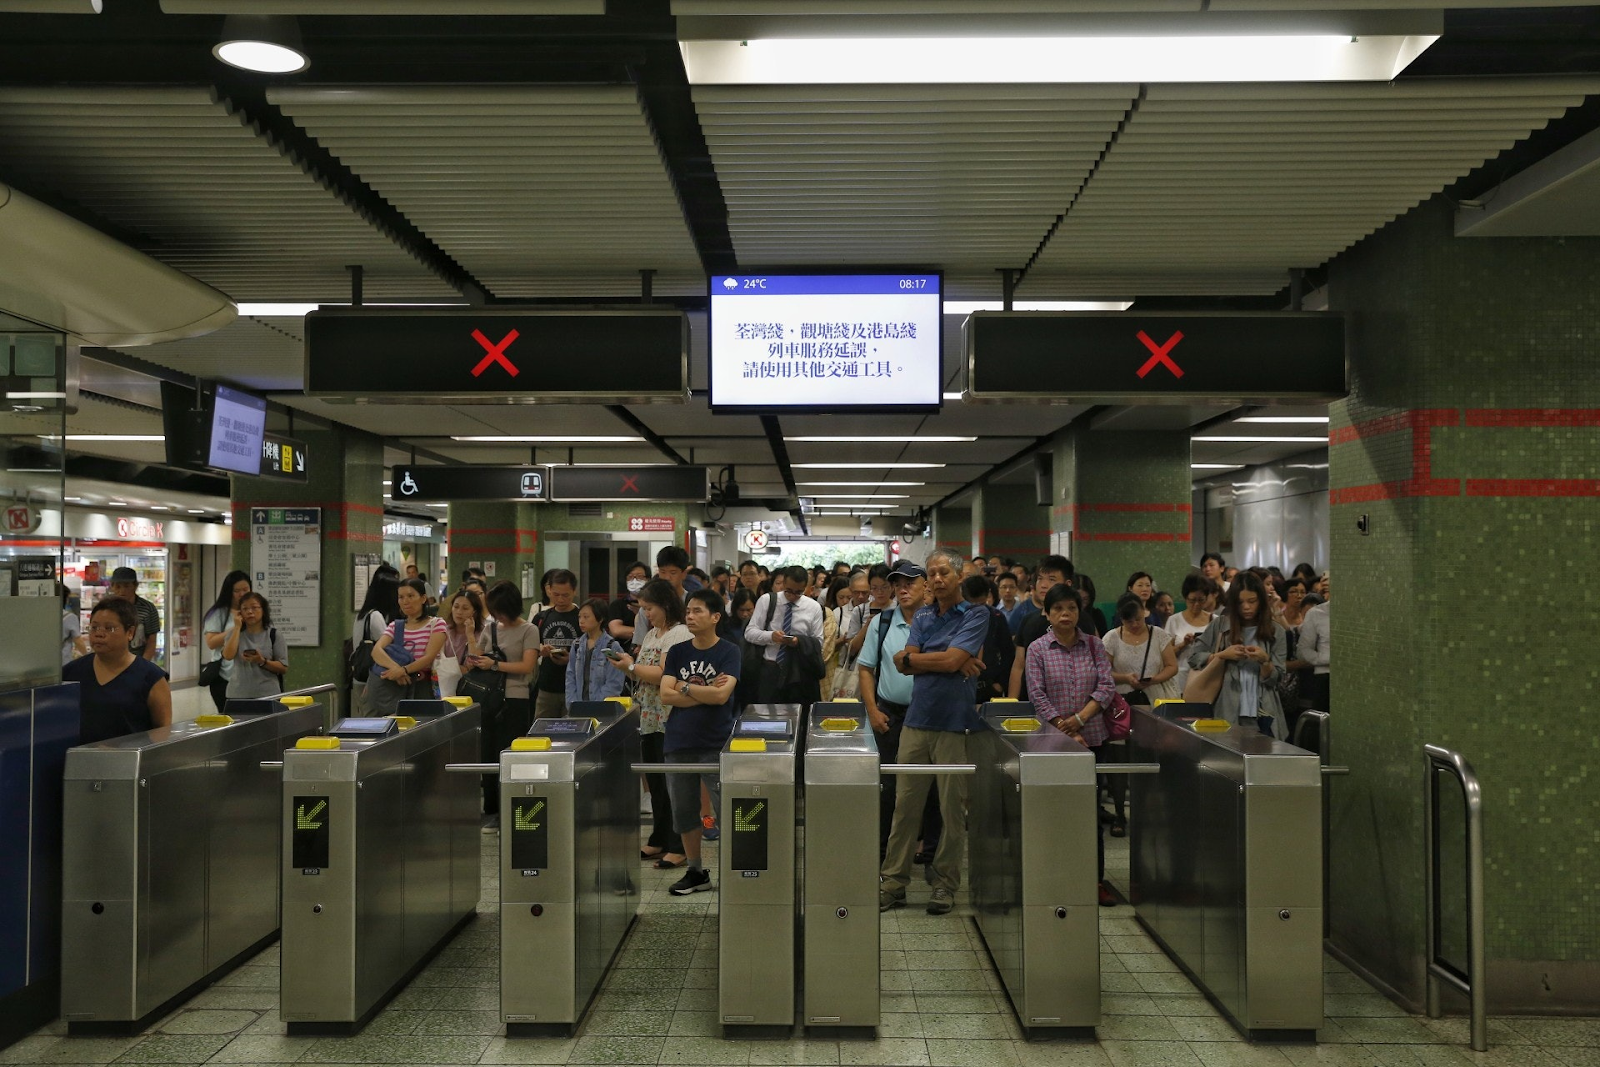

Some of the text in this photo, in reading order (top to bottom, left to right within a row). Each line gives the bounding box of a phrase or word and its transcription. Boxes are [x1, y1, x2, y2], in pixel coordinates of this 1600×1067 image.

[743, 278, 767, 289] 24°C
[899, 278, 927, 289] 08:17
[768, 341, 878, 359] 列車服務延誤，
[743, 360, 904, 378] 請使用其他交通工具。
[129, 521, 156, 538] Circle
[156, 522, 164, 538] K
[679, 660, 717, 686] & FAIT
